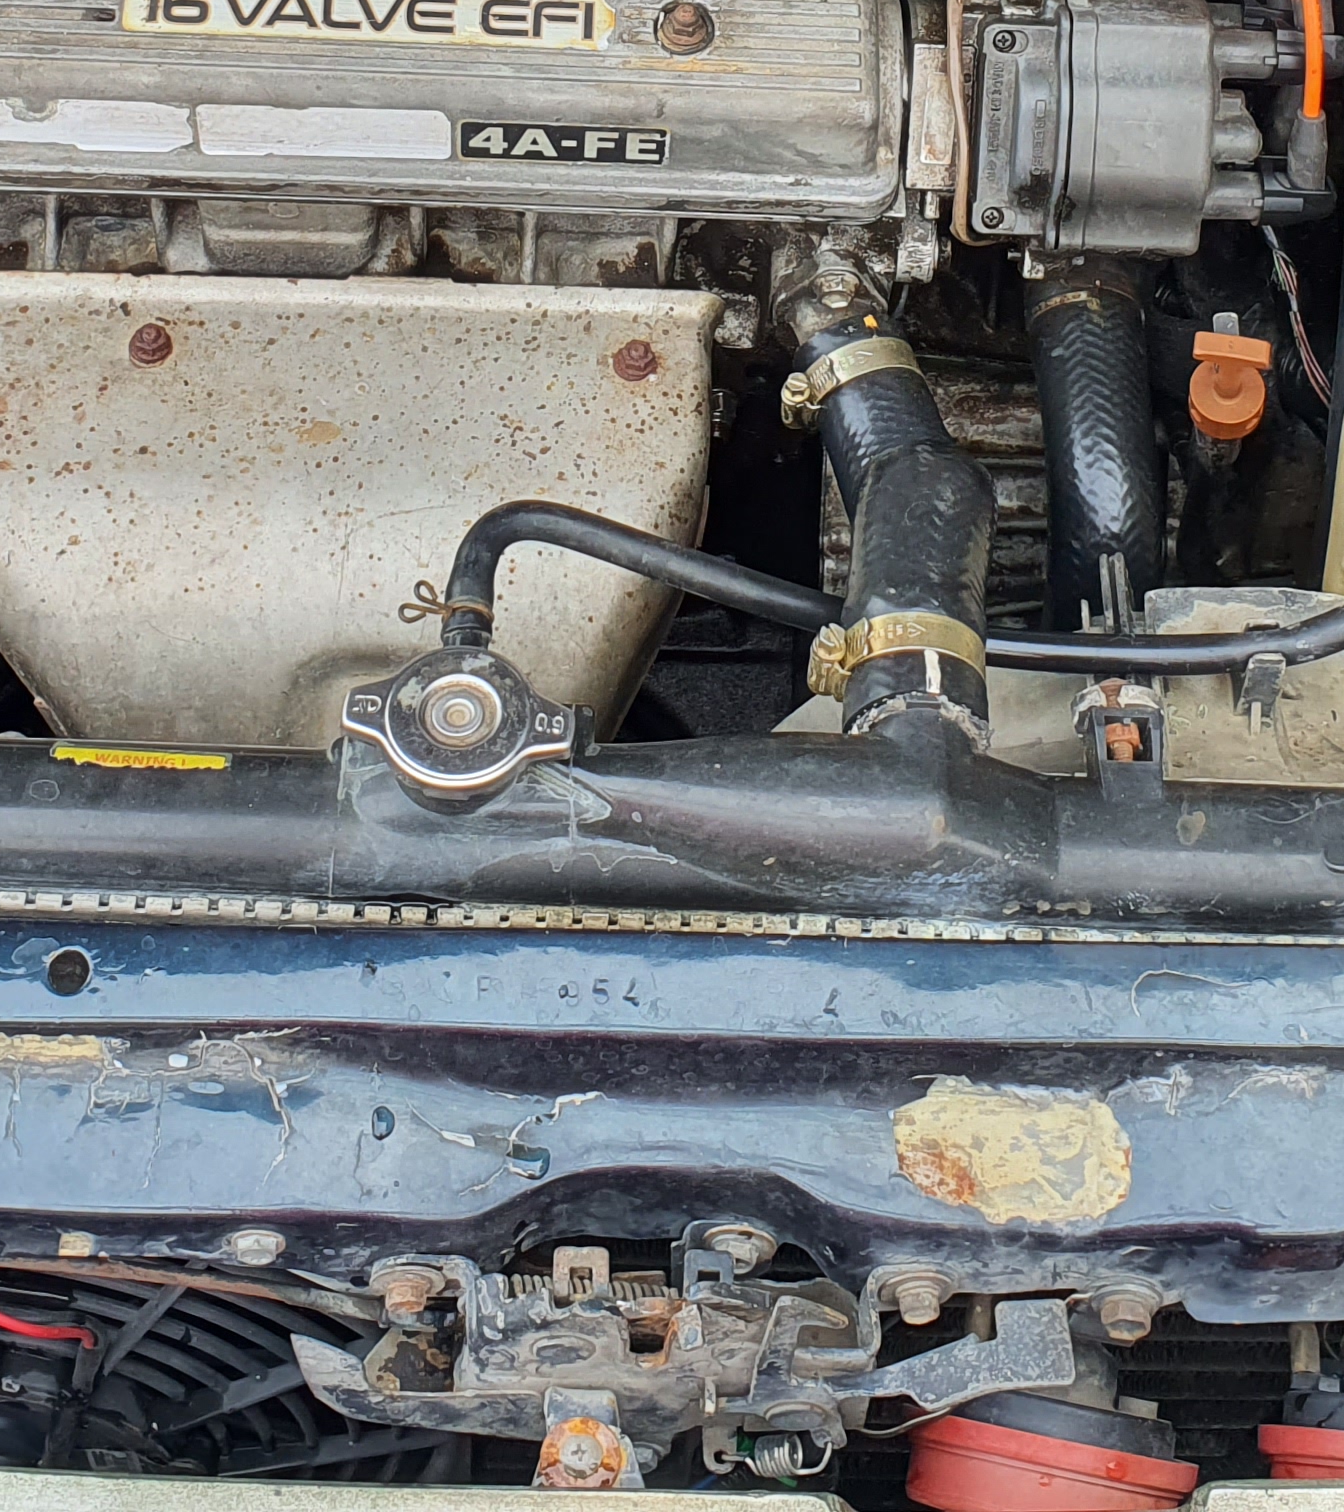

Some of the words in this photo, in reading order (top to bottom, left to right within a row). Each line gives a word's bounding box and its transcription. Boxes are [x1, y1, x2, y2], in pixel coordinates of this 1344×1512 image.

[467, 124, 665, 163] 4A-FE
[535, 711, 565, 735] 0.9
[95, 753, 176, 767] WARNING
